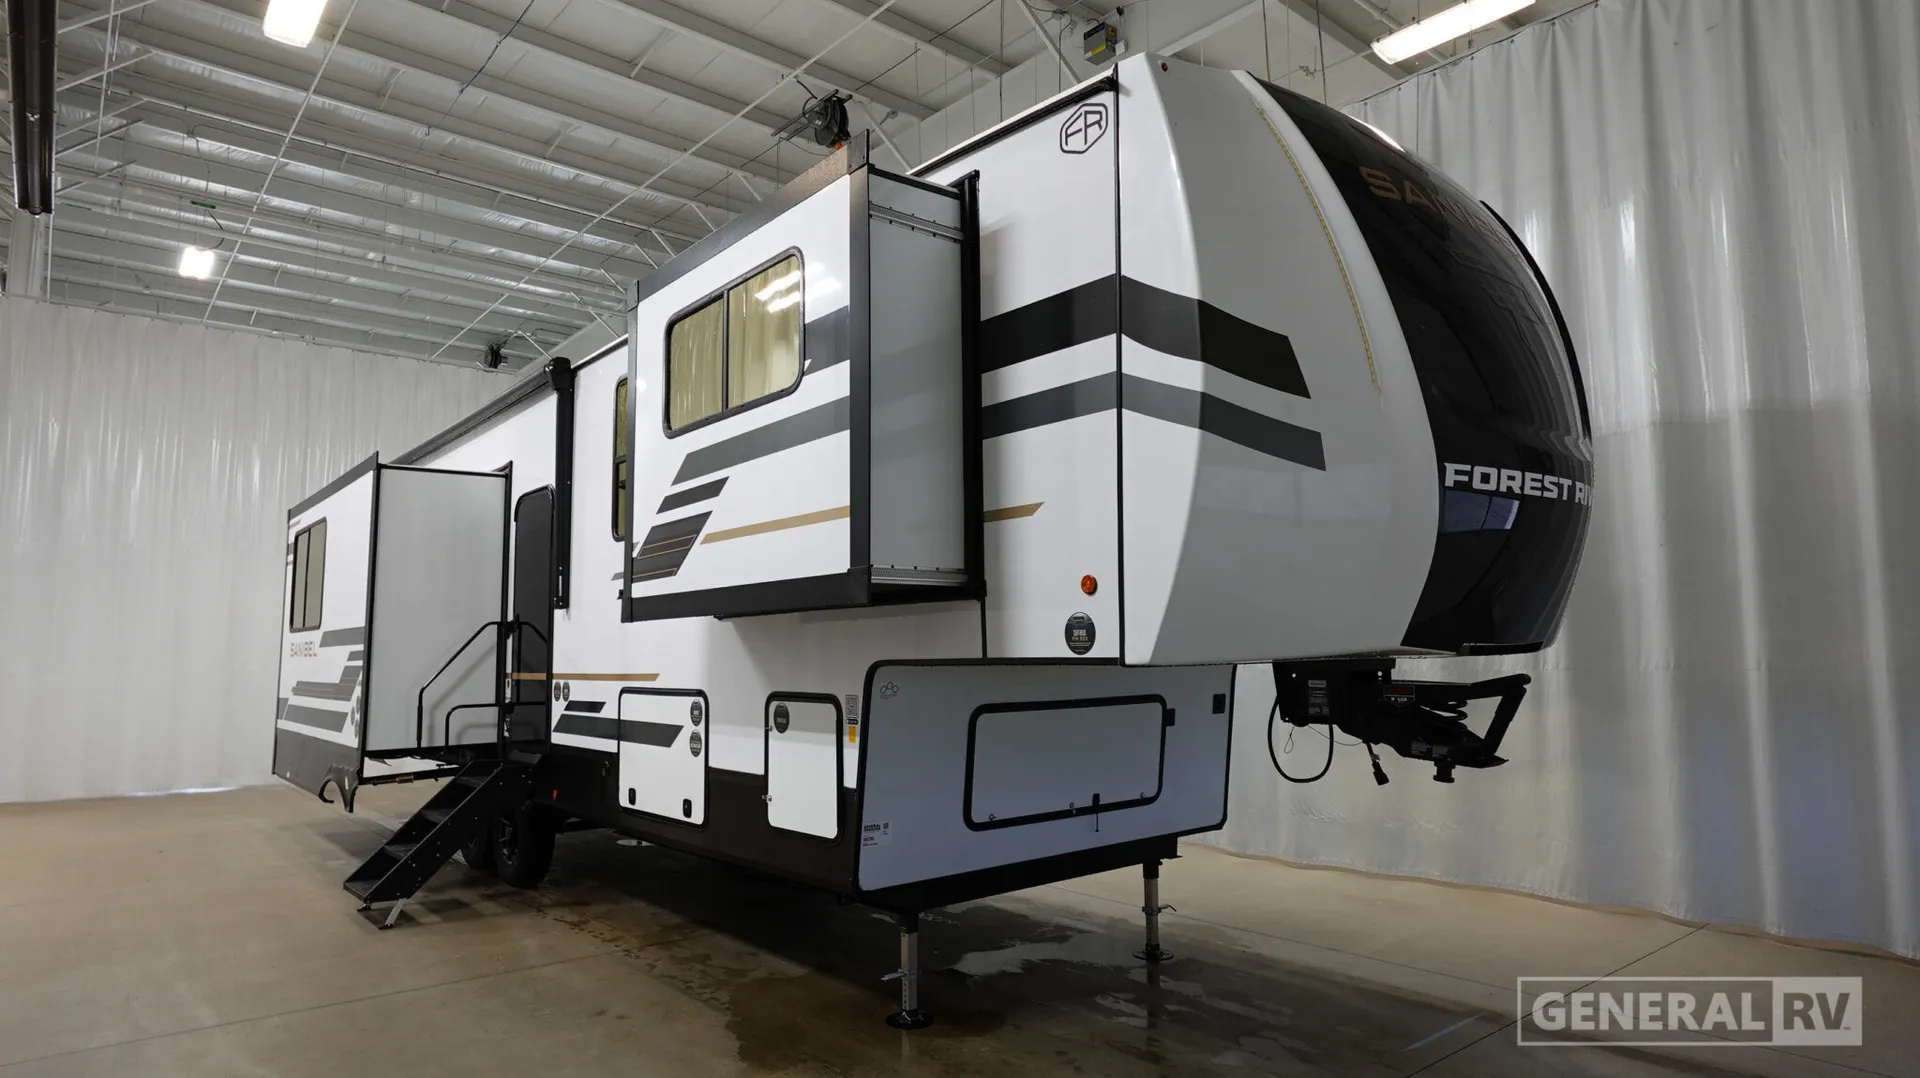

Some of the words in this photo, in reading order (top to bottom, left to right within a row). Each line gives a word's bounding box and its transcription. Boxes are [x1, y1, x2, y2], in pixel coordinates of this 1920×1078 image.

[1444, 462, 1572, 501] FOREST
[1574, 481, 1594, 507] RIV
[290, 640, 318, 658] SANIBEL
